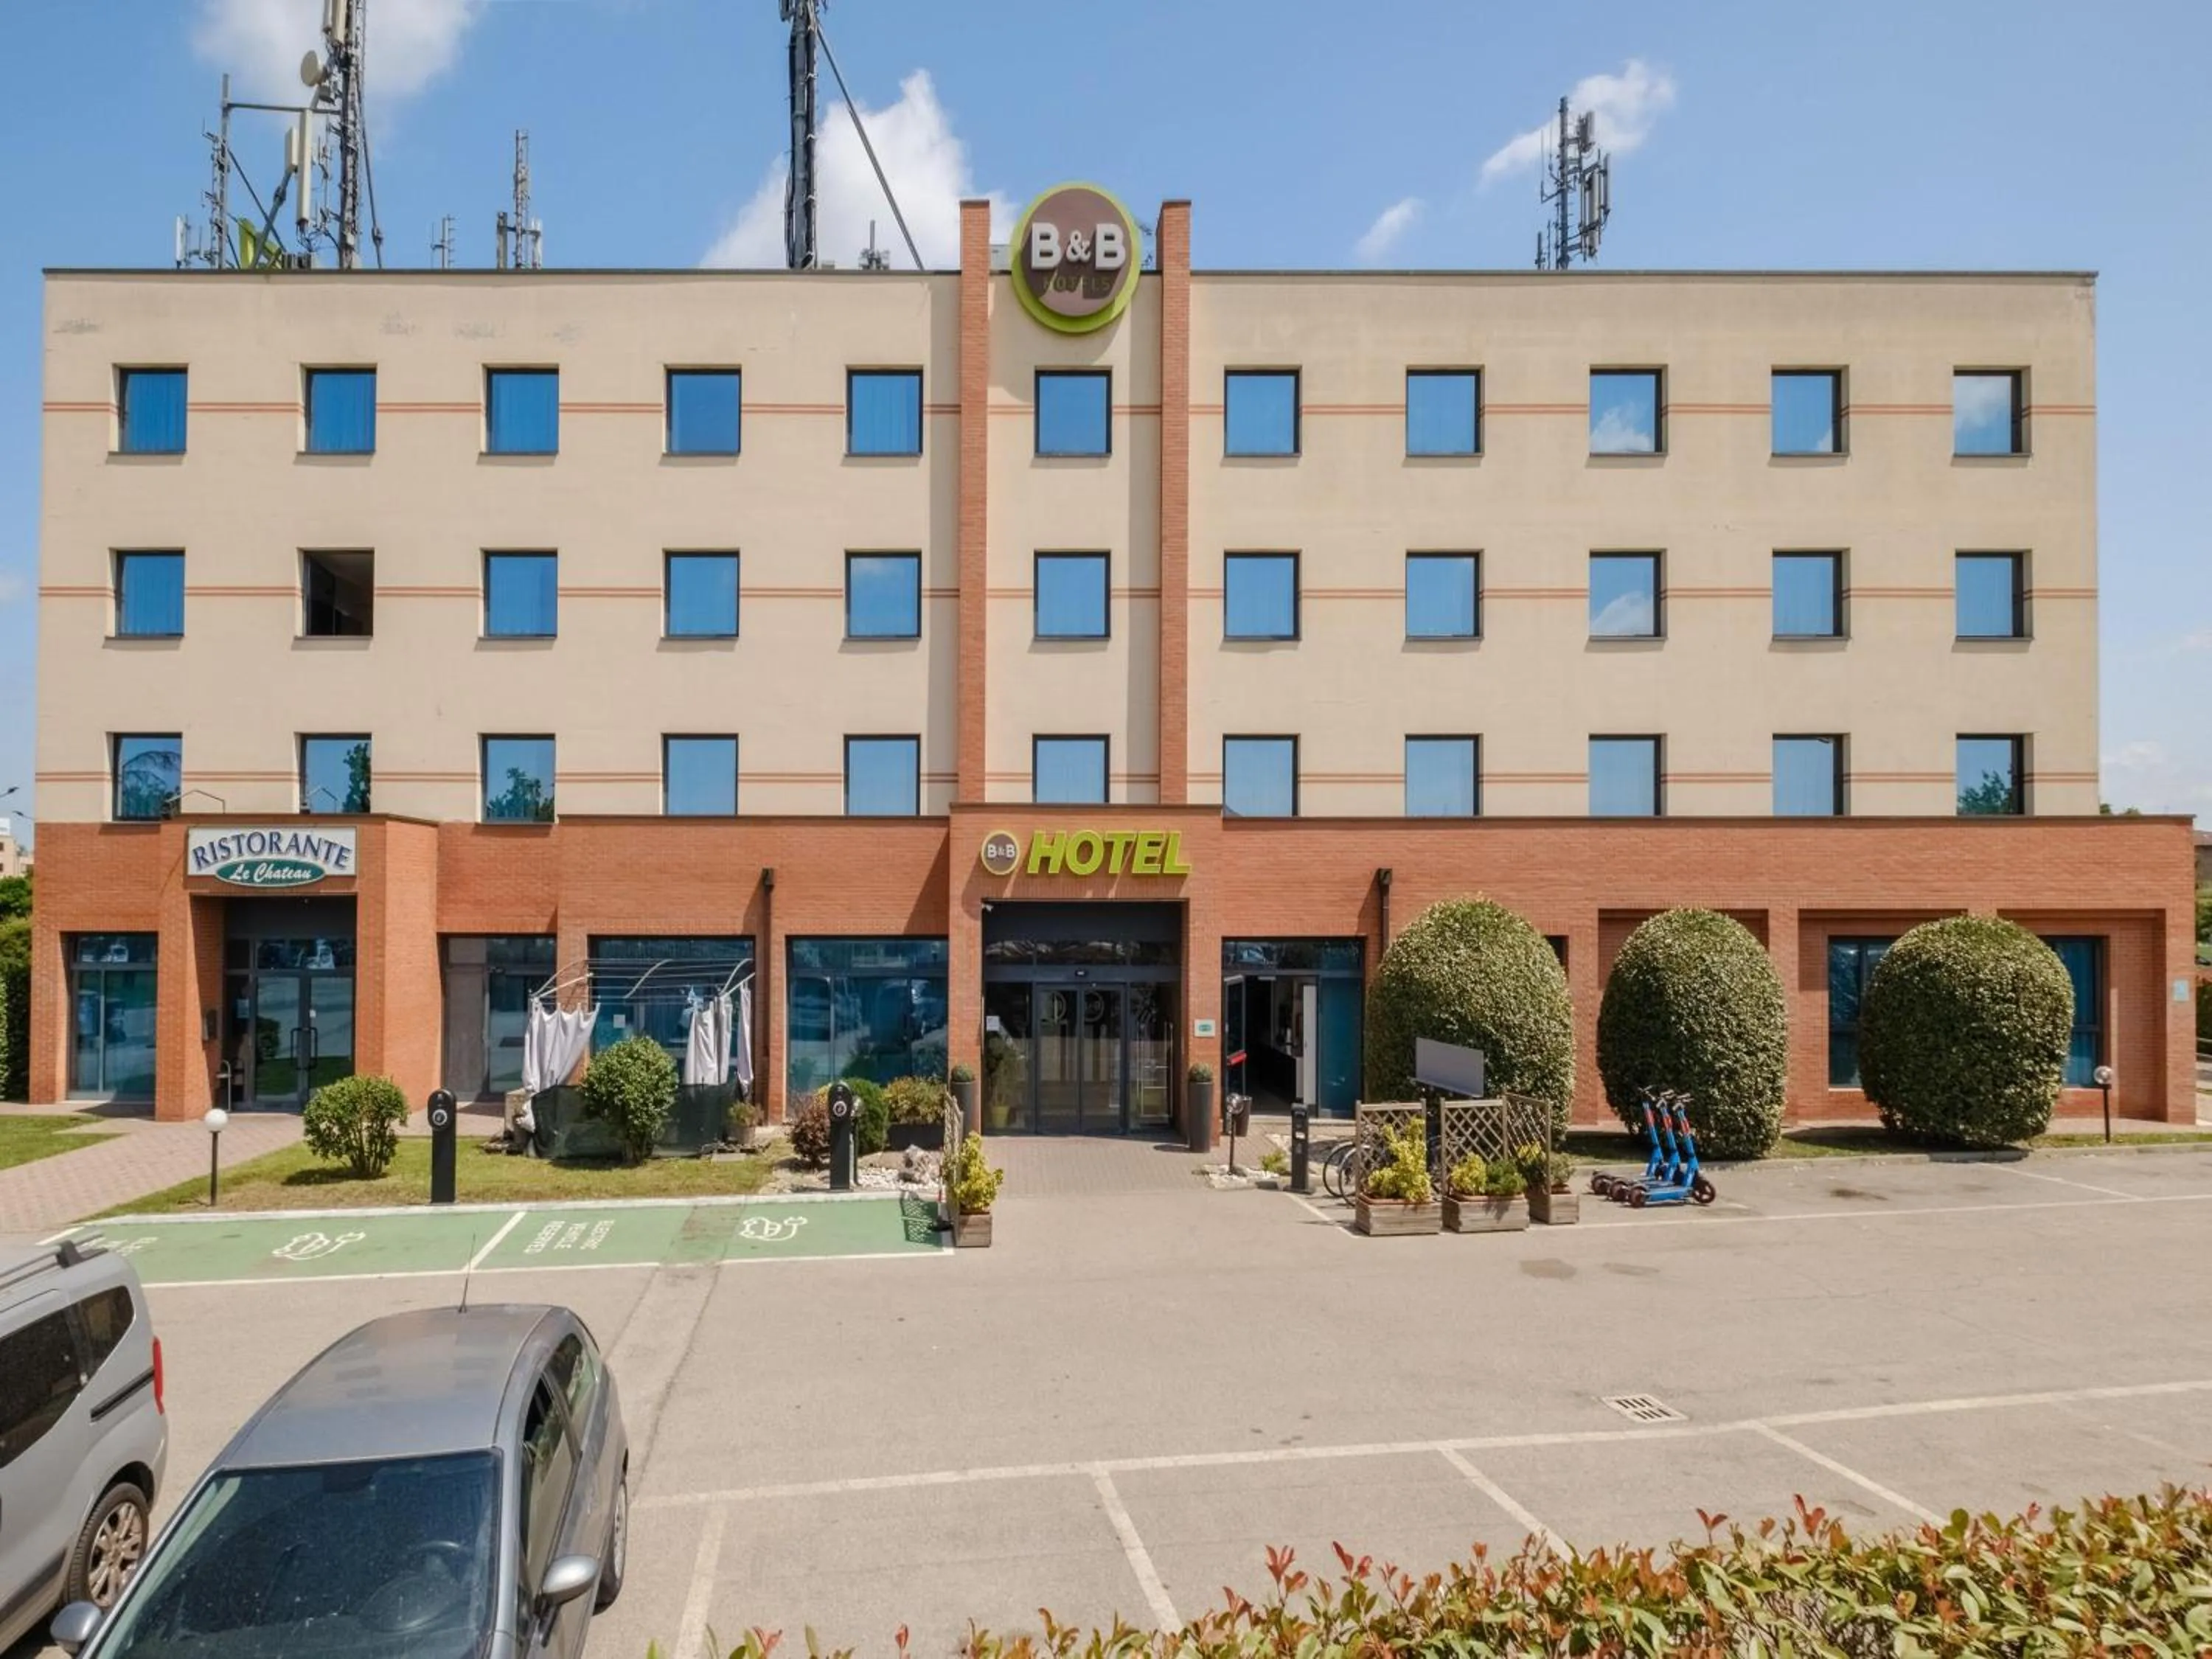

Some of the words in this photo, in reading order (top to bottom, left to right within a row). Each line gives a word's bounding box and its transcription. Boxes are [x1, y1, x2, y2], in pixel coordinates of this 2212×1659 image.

[1031, 222, 1127, 270] B&B
[192, 831, 352, 870] RISTORANTE
[987, 844, 1016, 859] B&B
[1027, 830, 1193, 875] HOTEL
[229, 863, 251, 881] Le
[253, 861, 312, 883] Chateau
